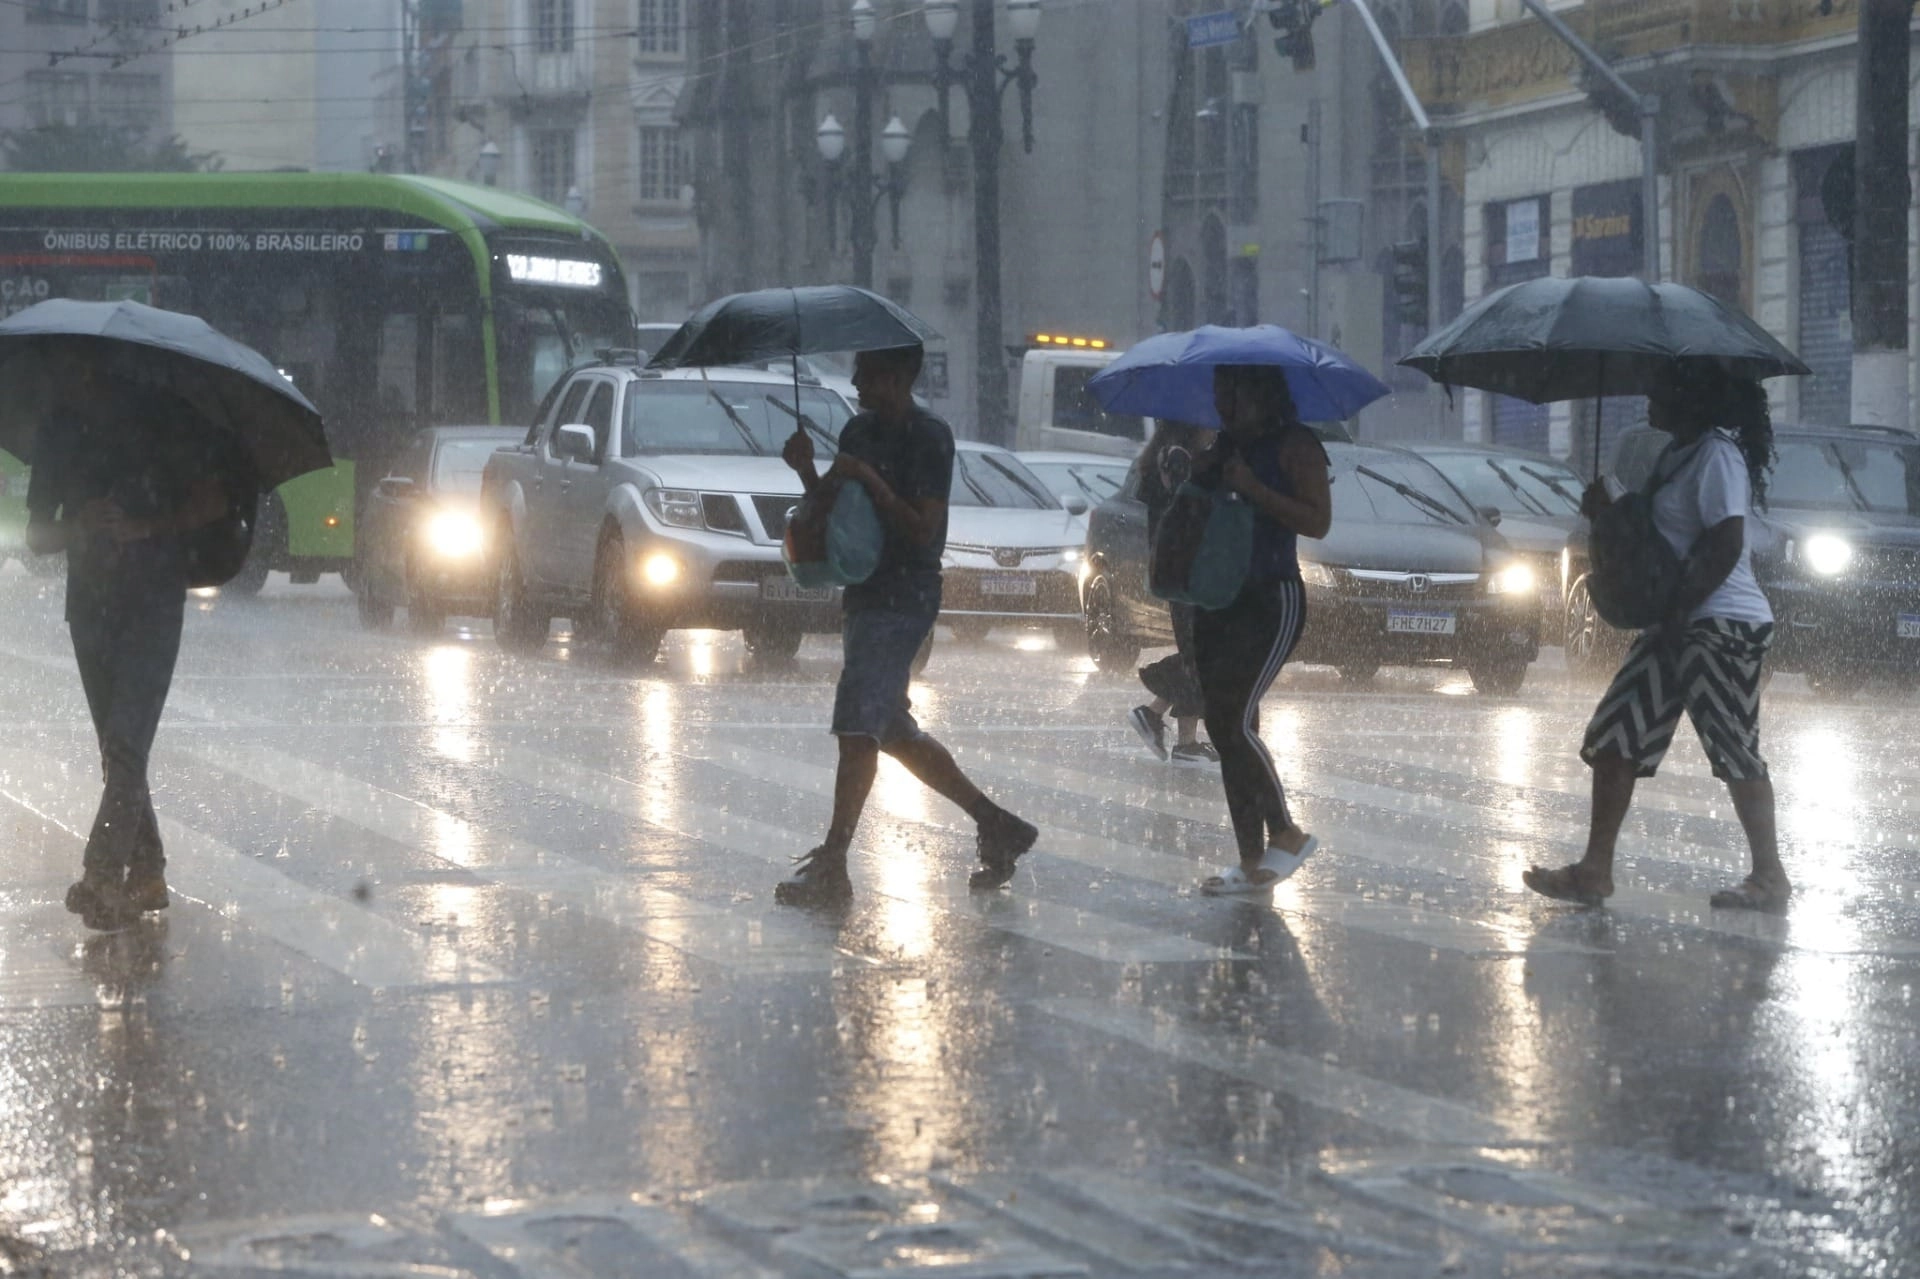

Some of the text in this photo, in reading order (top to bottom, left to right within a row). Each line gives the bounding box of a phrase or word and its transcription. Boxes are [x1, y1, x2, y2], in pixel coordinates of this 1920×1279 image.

[43, 229, 363, 252] ÔNIBUS ELÉTRICO 100% BRASILEIRO
[1392, 616, 1448, 631] FHE7H27
